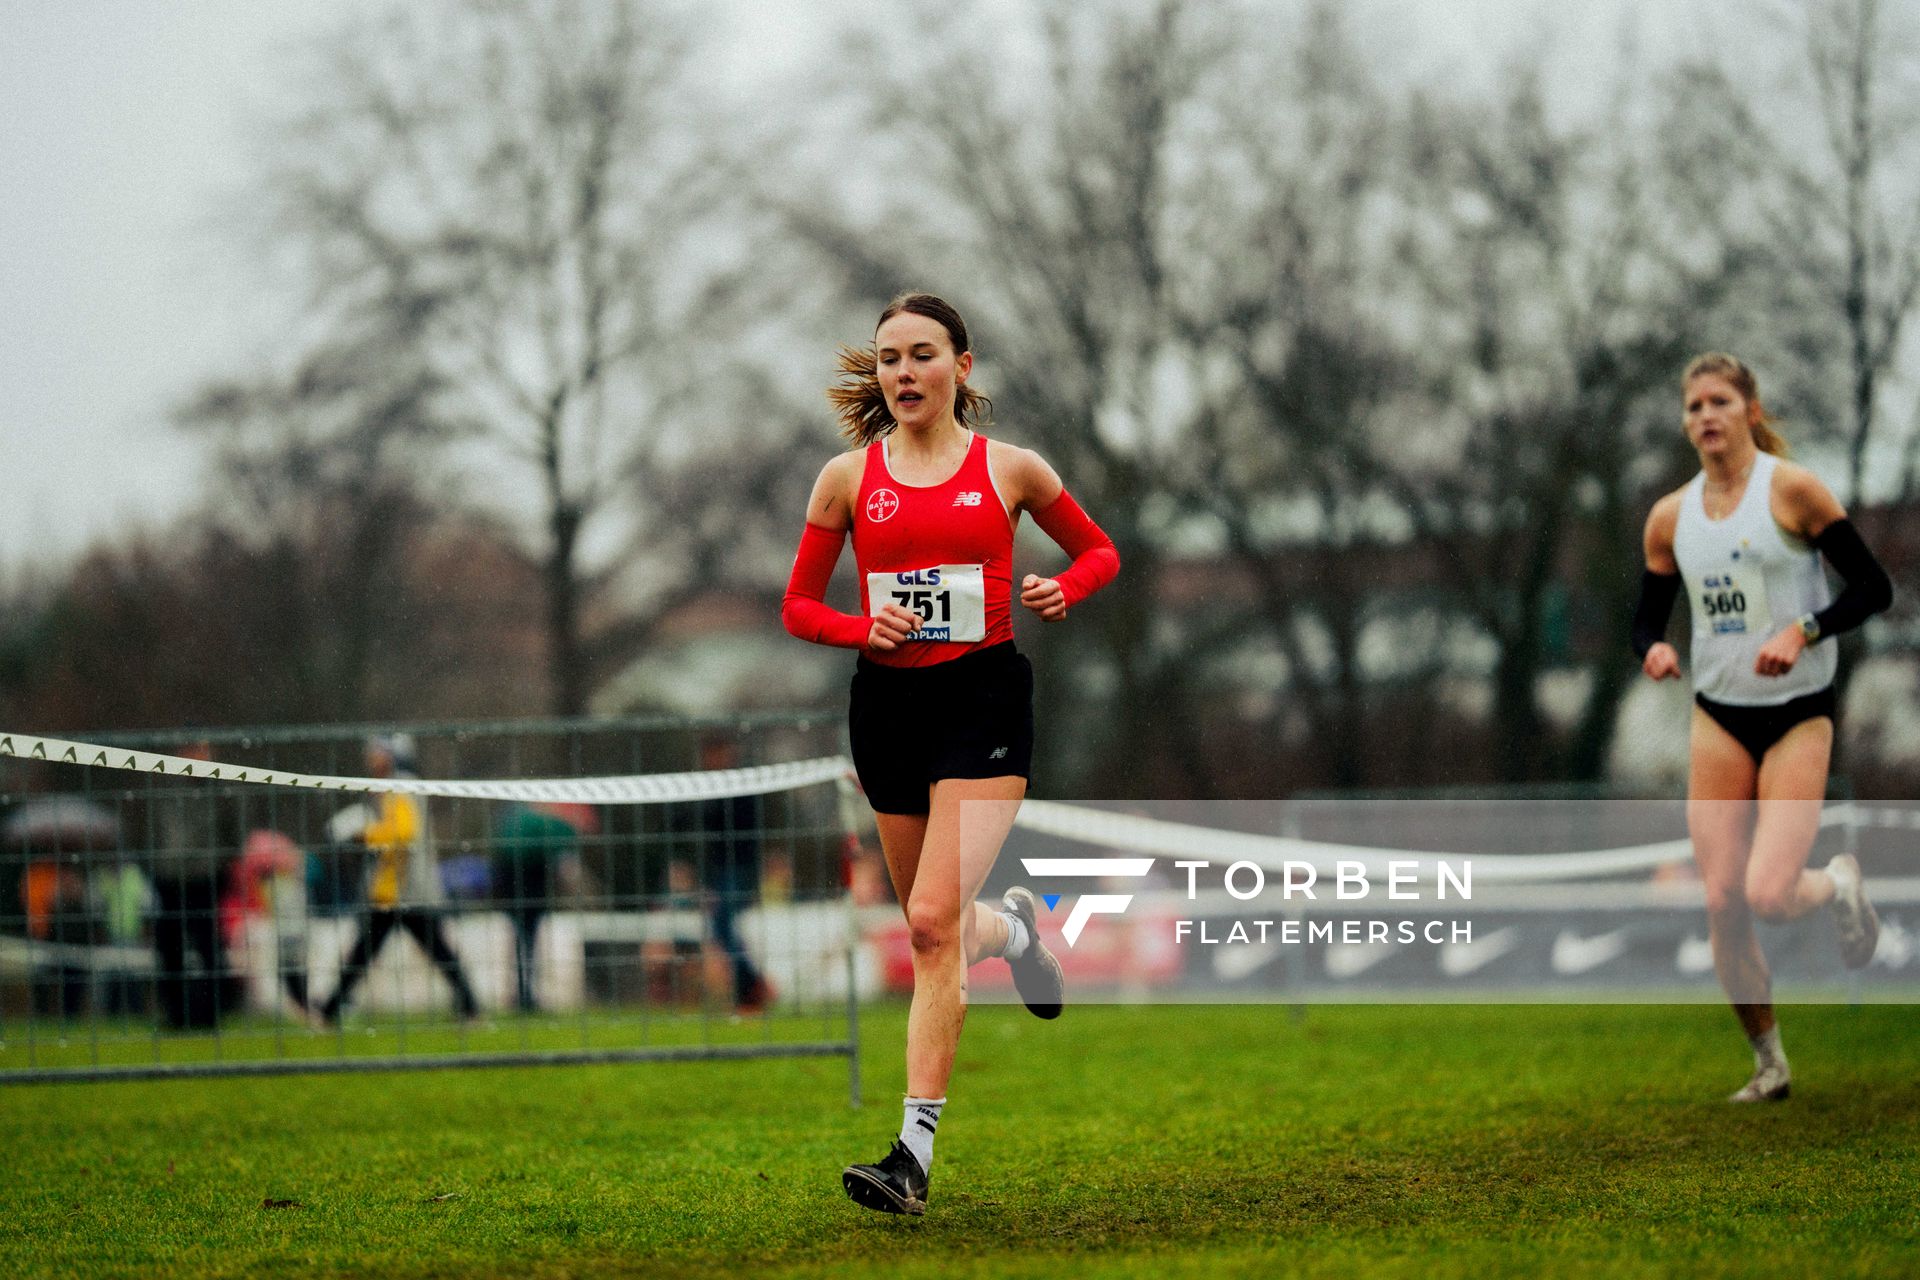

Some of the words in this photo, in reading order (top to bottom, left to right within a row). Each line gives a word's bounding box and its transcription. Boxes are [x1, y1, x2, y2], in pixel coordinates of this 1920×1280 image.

[868, 500, 896, 511] BAYER
[896, 568, 941, 586] GLS
[891, 590, 951, 622] 751
[1703, 592, 1746, 615] 560
